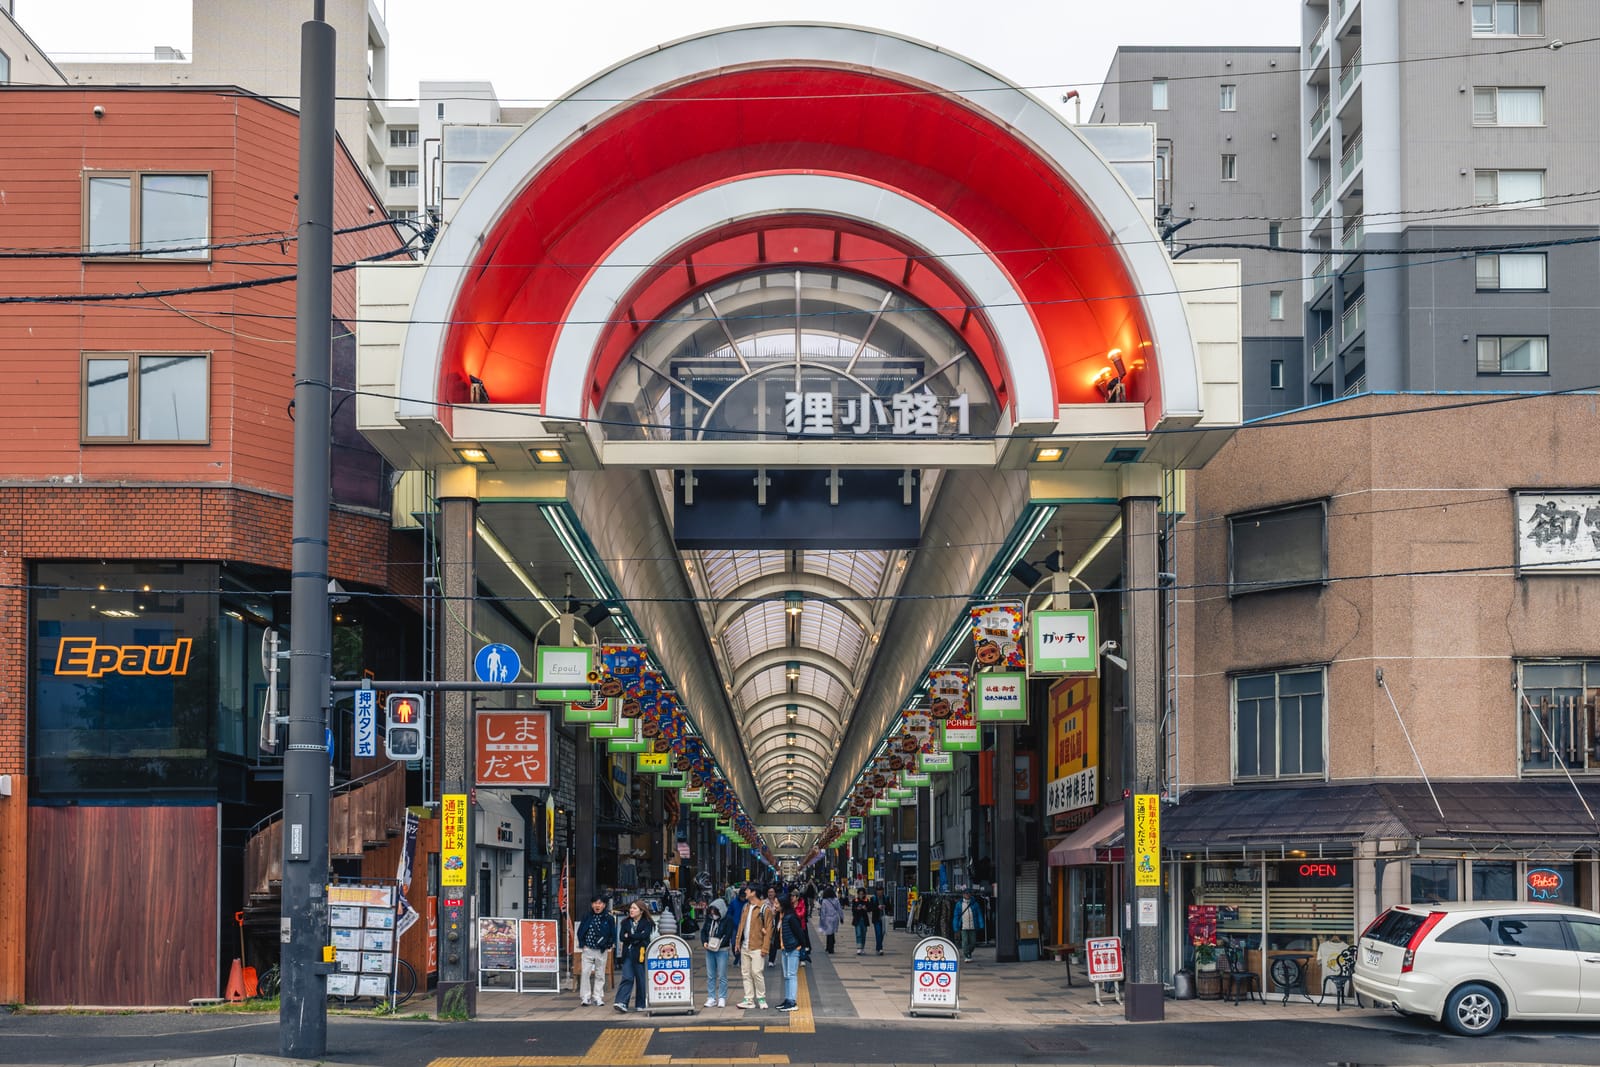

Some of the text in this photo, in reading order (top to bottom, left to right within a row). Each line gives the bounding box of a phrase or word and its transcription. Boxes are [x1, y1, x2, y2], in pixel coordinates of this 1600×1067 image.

[785, 392, 970, 434] 狸小路1
[54, 637, 193, 678] Epaul
[1043, 632, 1085, 644] ガッチャ
[359, 692, 372, 755] 押ボタン式
[445, 800, 456, 850] 通行禁止
[1137, 798, 1146, 854] ご通行ください
[1148, 797, 1157, 853] 自転車から降りて
[1300, 864, 1336, 876] OPEN
[1531, 874, 1558, 887] Pabst
[650, 959, 688, 969] 歩行者専用
[917, 961, 955, 971] 歩行者専用
